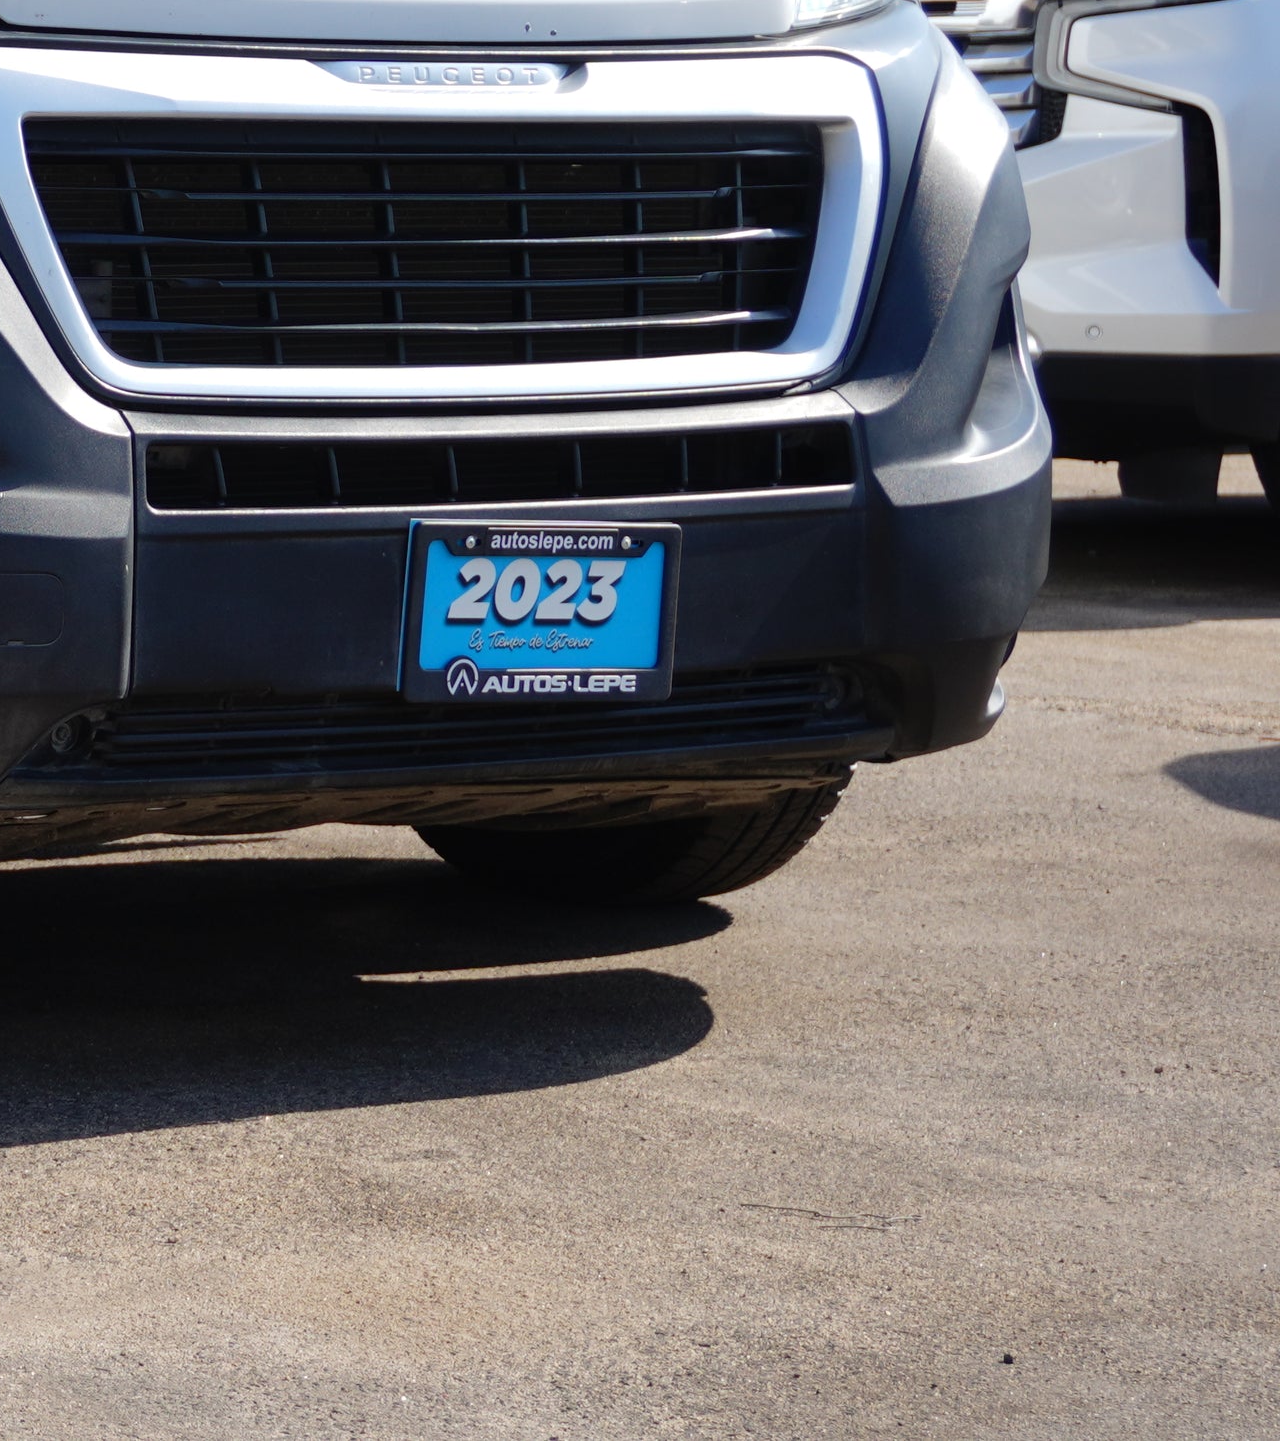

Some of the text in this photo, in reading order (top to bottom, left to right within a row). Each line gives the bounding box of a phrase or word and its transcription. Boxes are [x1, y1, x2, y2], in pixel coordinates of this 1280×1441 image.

[357, 65, 540, 85] PEUGEOT
[490, 529, 614, 553] autoslepe.com
[446, 558, 627, 622] 2023
[469, 628, 595, 651] Es Tiempo de Estrenar
